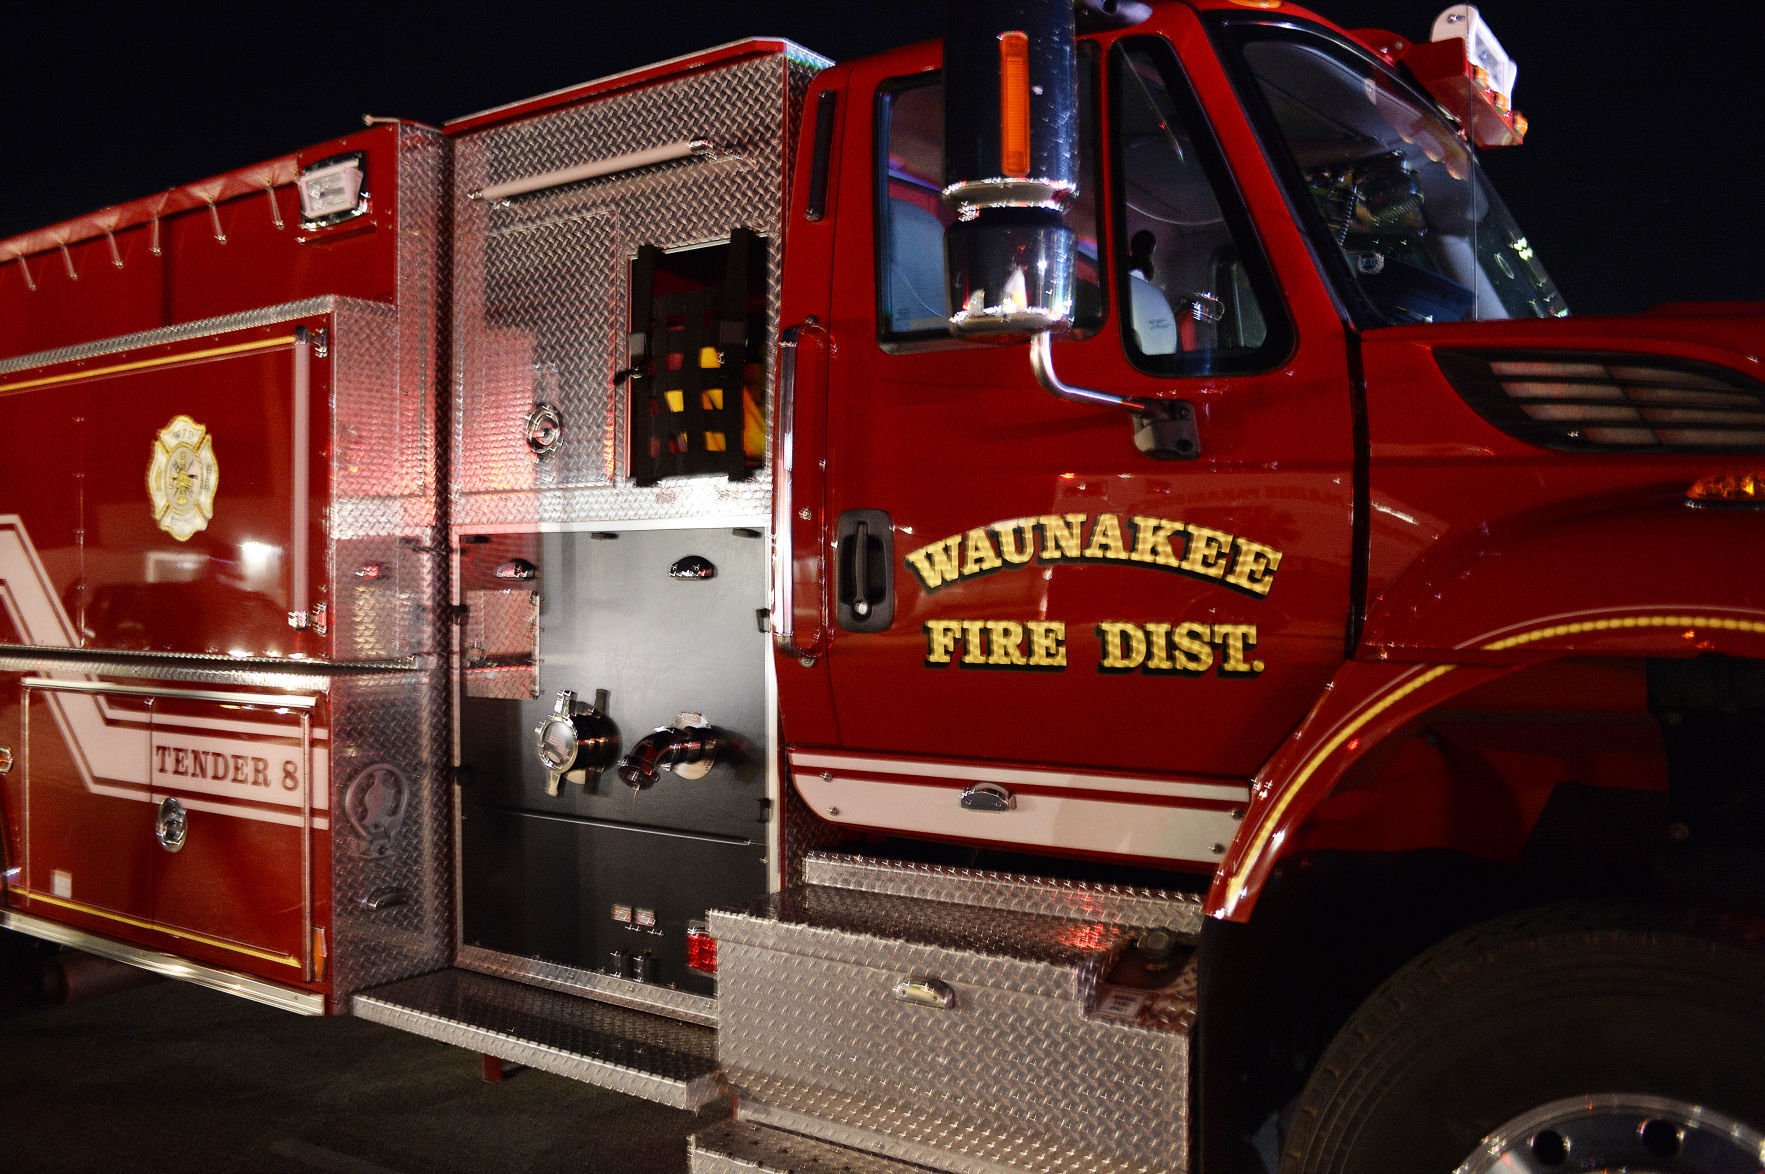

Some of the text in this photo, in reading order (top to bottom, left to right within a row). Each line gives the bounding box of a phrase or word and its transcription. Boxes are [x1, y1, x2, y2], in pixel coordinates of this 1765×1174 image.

[906, 512, 1283, 597] WAUNAKEE
[925, 619, 1265, 674] FIRE DIST.
[156, 745, 299, 792] TENDER 8
